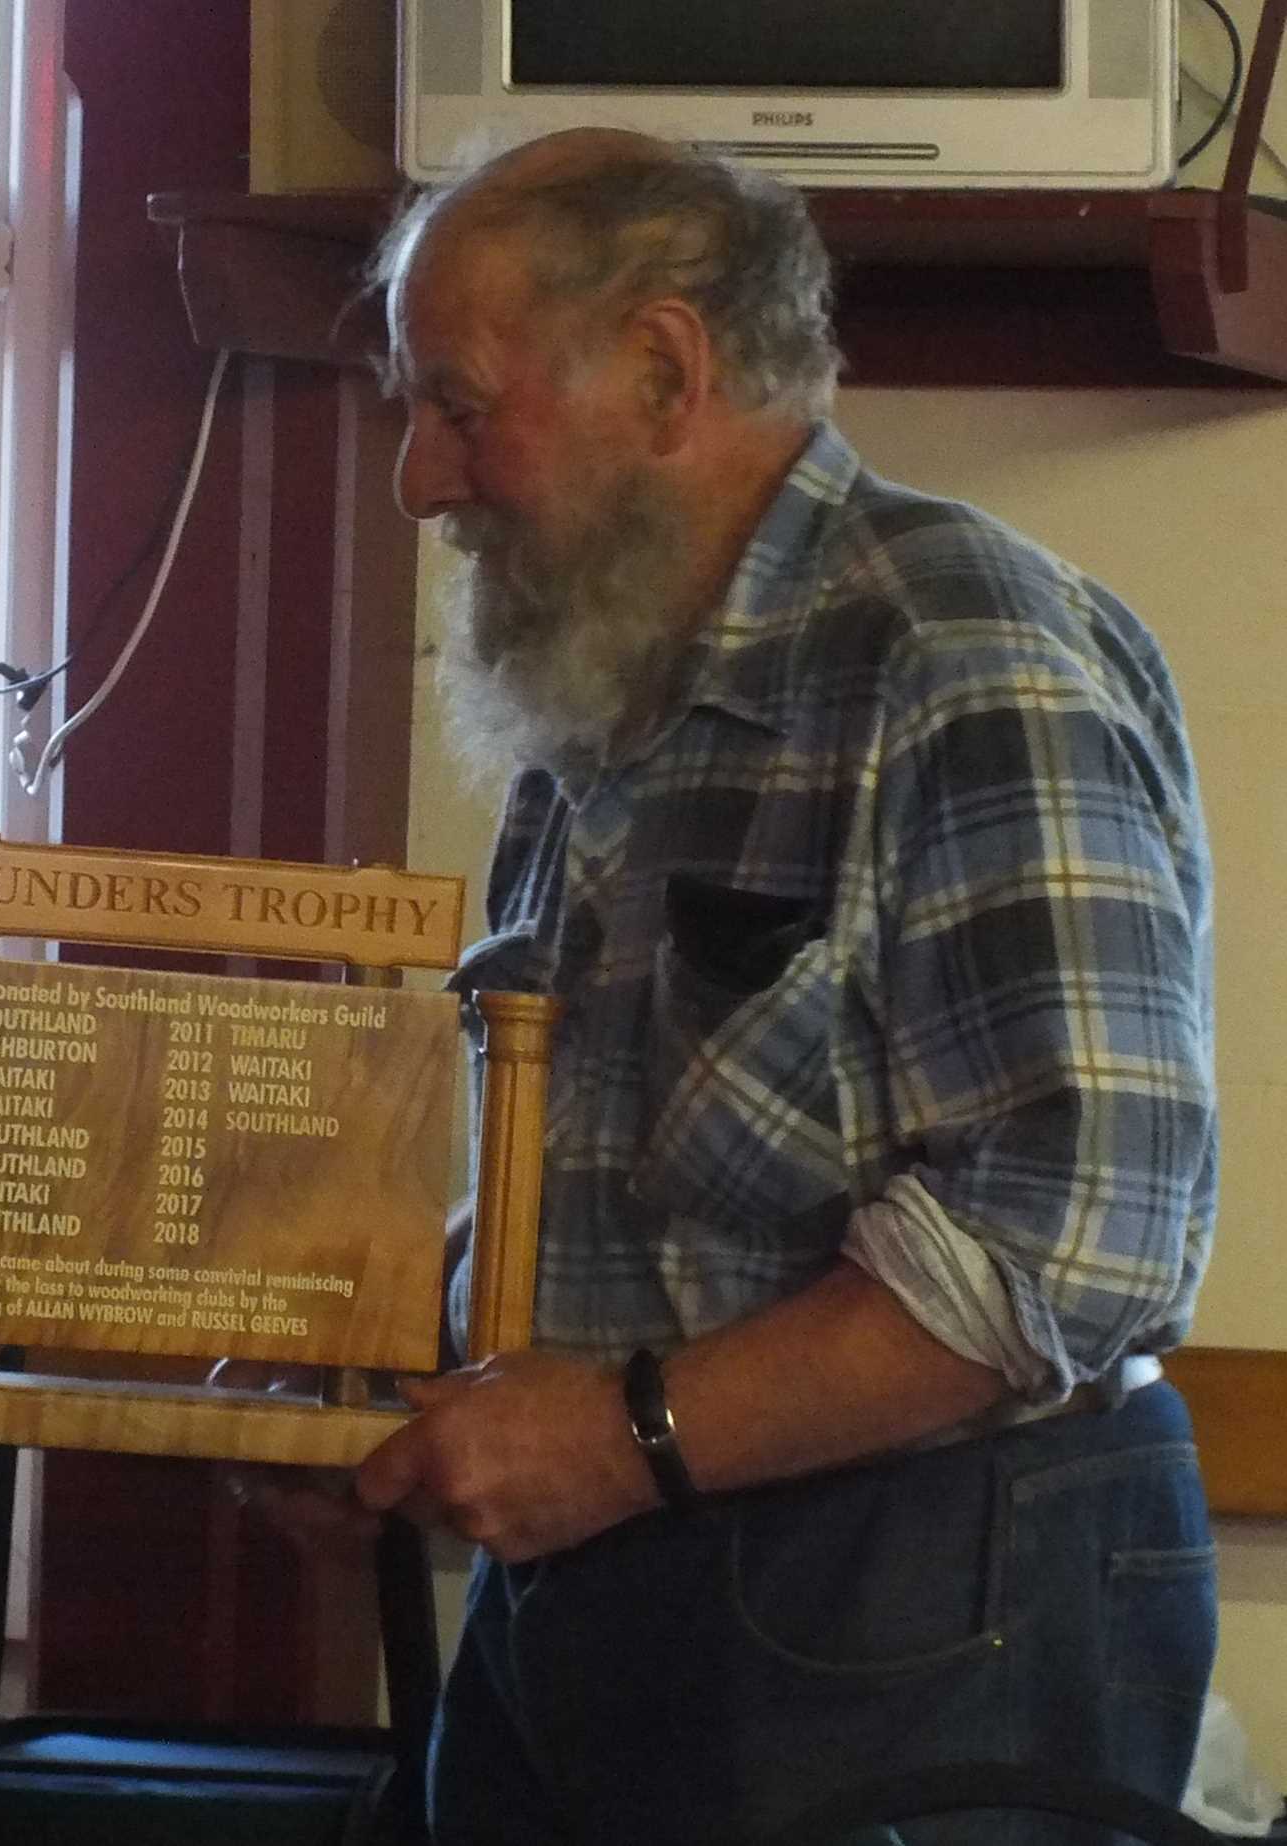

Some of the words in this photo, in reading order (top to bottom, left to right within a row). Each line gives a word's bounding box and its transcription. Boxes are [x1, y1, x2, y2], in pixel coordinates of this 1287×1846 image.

[752, 111, 813, 127] PHILIPS
[223, 881, 438, 936] TROPHY
[68, 983, 90, 1011] by
[95, 986, 191, 1015] Southland
[198, 993, 328, 1024] Woodworkers
[334, 1004, 386, 1029] Guild
[169, 1021, 213, 1044] 2011
[230, 1024, 307, 1050] TIMARU
[166, 1049, 213, 1073] 2012
[230, 1054, 312, 1081] WAITAKI
[164, 1078, 212, 1101] 2013
[229, 1081, 310, 1107] WAITAKI
[163, 1106, 209, 1130] 2014
[225, 1110, 340, 1137] SOUTHLAND
[161, 1135, 206, 1159] 2015
[158, 1164, 205, 1188] 2016
[155, 1193, 203, 1216] 2017
[153, 1221, 200, 1245] 2018
[0, 1255, 42, 1272] came
[45, 1254, 90, 1274] about
[94, 1257, 144, 1283] during
[148, 1266, 189, 1282] some
[193, 1266, 261, 1287] convivial
[266, 1271, 354, 1298] reminiscing
[5, 1274, 30, 1294] the
[68, 1281, 84, 1298] to
[88, 1283, 192, 1309] woodworking
[196, 1287, 235, 1308] clubs
[240, 1290, 258, 1312] by
[262, 1292, 287, 1312] the
[6, 1298, 23, 1316] of
[26, 1299, 74, 1320] ALLAN
[79, 1302, 153, 1324] WYBROW
[157, 1308, 187, 1328] and
[191, 1310, 246, 1333] RUSSEL
[250, 1314, 308, 1336] GEEVES
